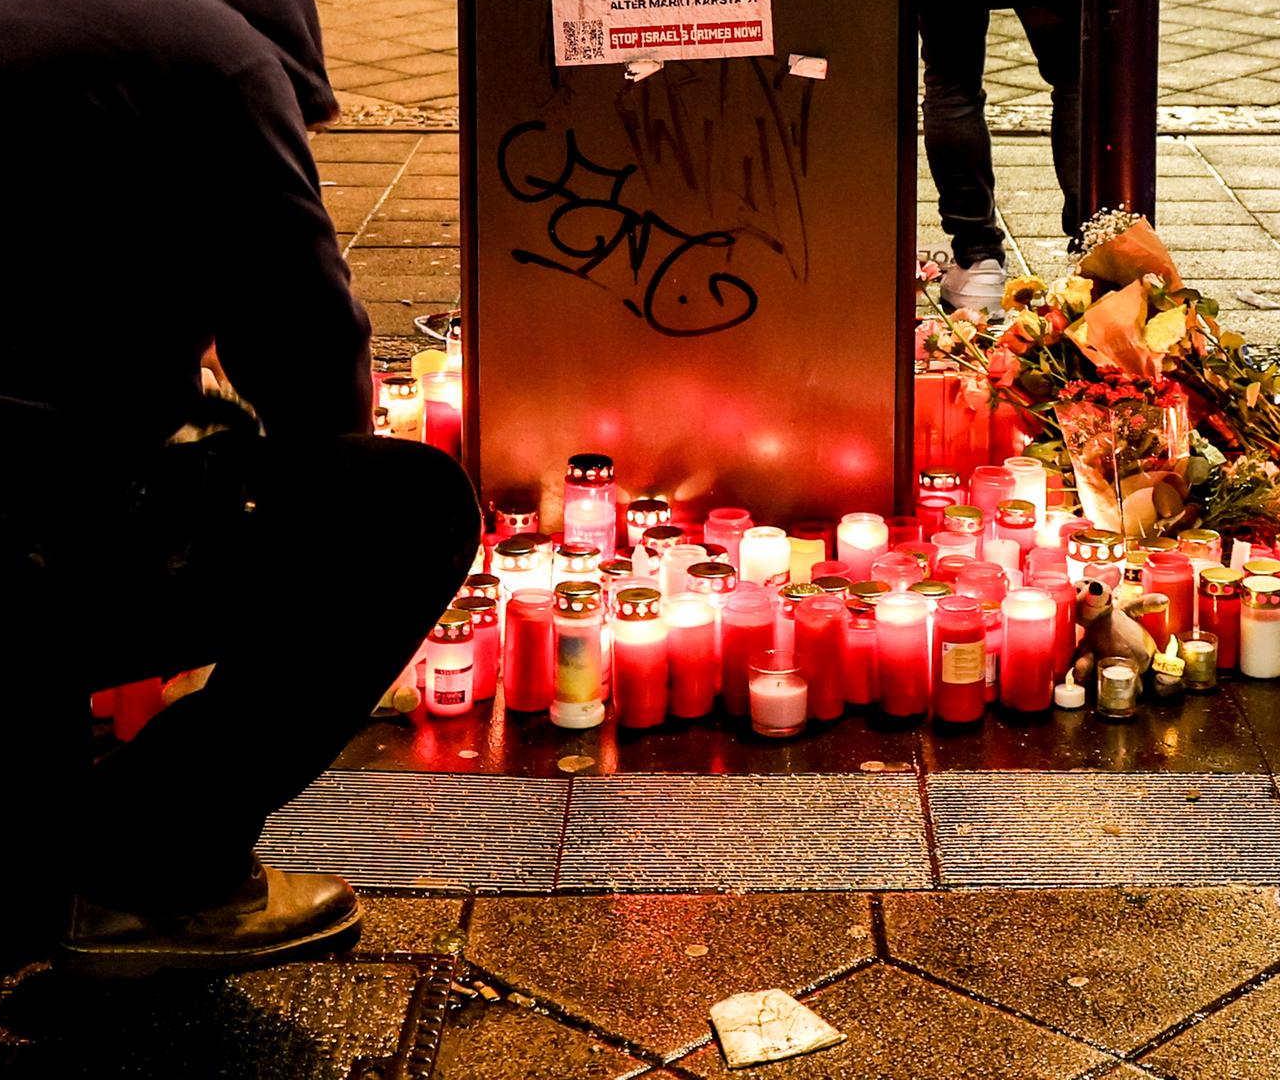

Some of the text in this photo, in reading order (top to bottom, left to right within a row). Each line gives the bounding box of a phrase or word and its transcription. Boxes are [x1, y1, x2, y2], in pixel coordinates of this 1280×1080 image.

[610, 0, 646, 11] ALTER
[611, 32, 638, 46] STOP
[690, 27, 732, 41] CRIMES
[734, 26, 762, 38] NOW!
